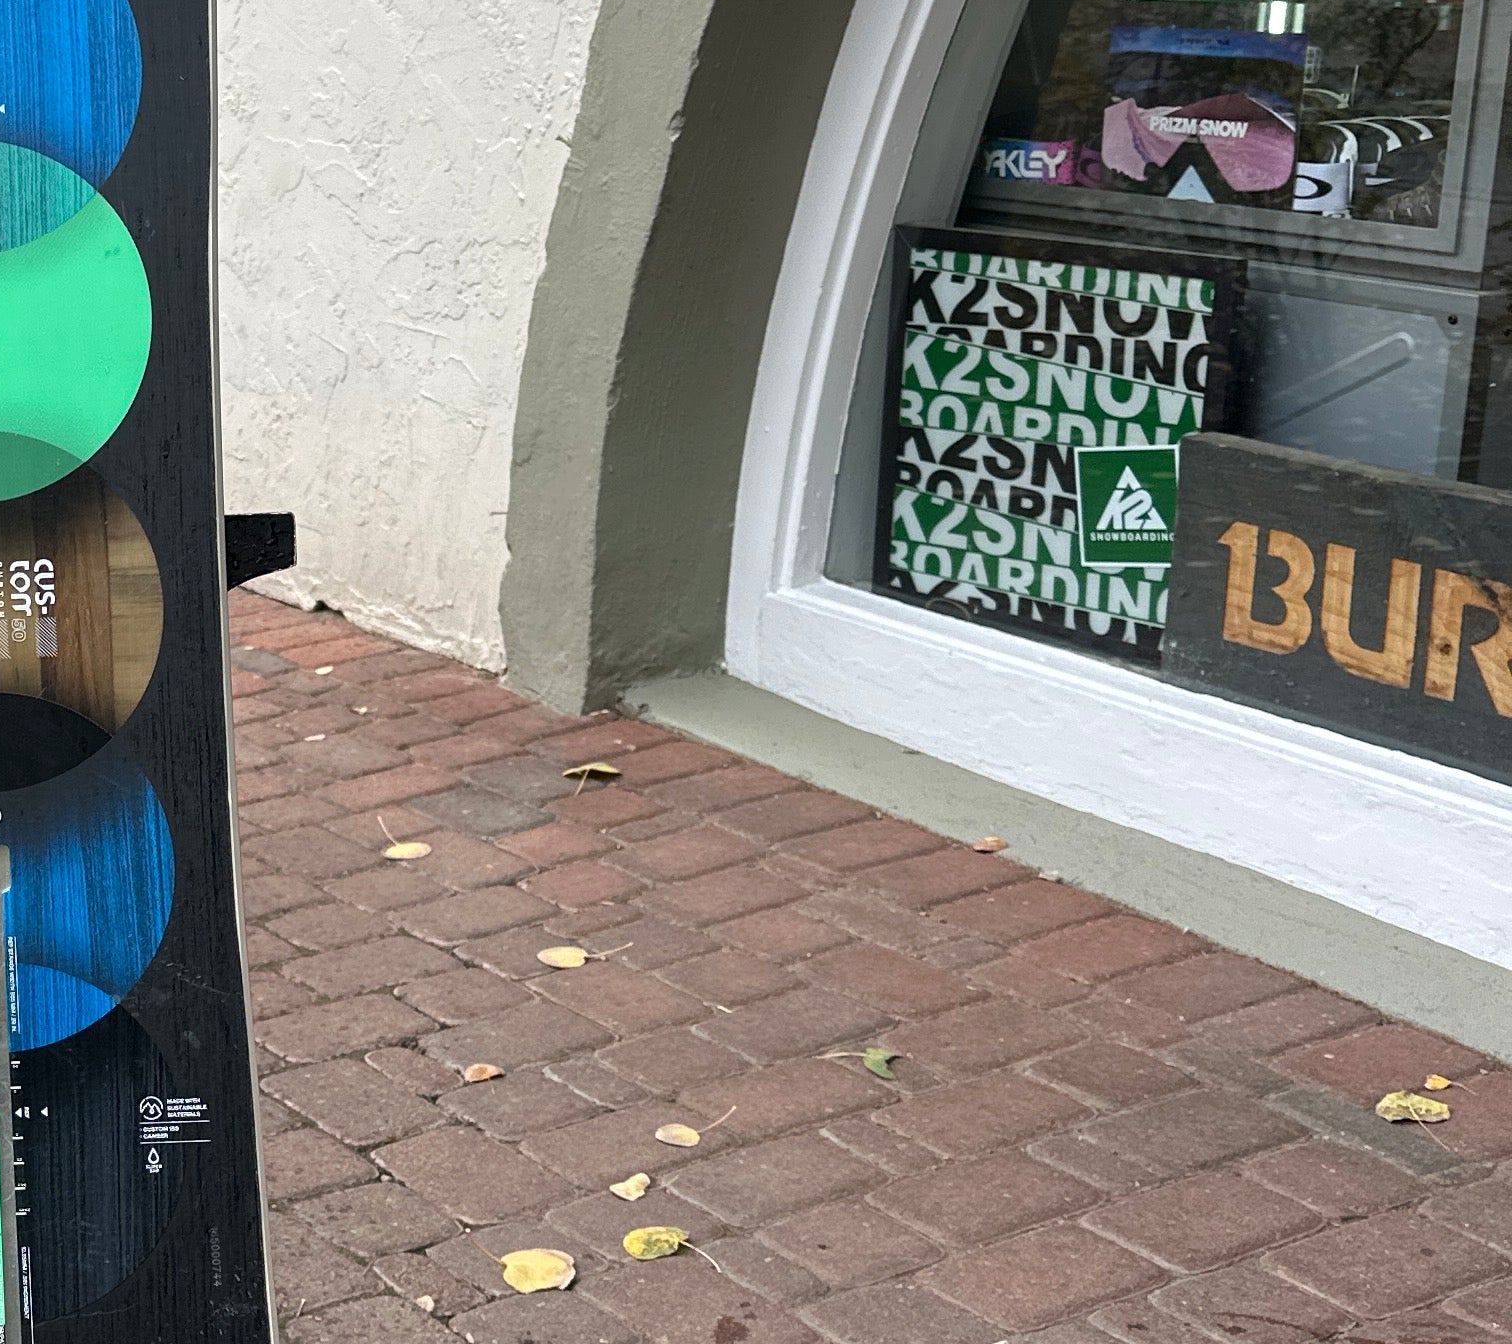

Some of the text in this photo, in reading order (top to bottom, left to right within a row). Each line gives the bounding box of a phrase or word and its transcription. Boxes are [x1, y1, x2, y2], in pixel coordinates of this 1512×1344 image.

[1149, 116, 1249, 139] PRIZM SNOW
[899, 389, 1172, 447] BOARDIN
[896, 426, 1079, 497] K2SN
